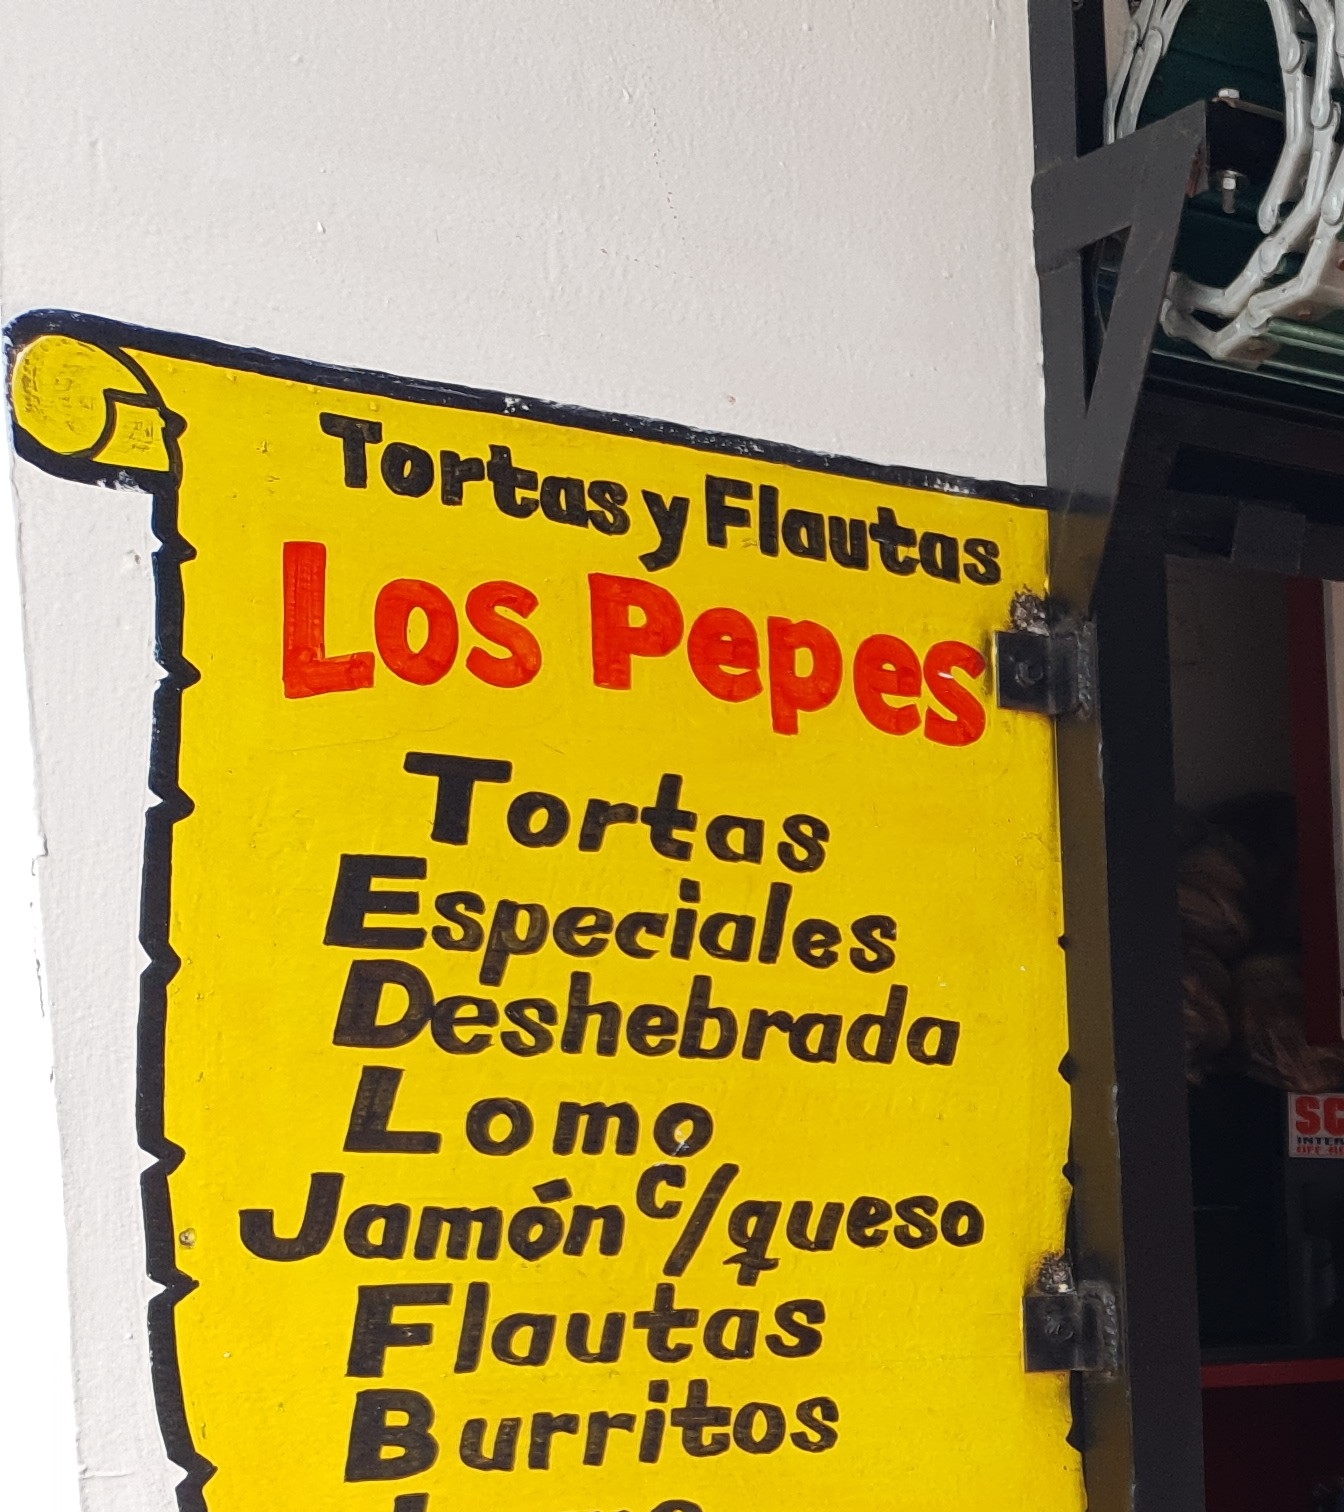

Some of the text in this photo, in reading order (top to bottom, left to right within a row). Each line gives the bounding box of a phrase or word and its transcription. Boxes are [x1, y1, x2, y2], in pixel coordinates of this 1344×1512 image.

[320, 411, 1001, 586] Tortas y Flautas
[282, 541, 987, 747] Los Pepes
[403, 751, 830, 873] Tortas
[323, 853, 897, 987] Especiales
[332, 959, 960, 1066] Deshebrada
[343, 1065, 714, 1158] Lomo
[238, 1171, 625, 1262] Jamón
[346, 1281, 825, 1378] Flautas
[344, 1378, 839, 1483] Burritos
